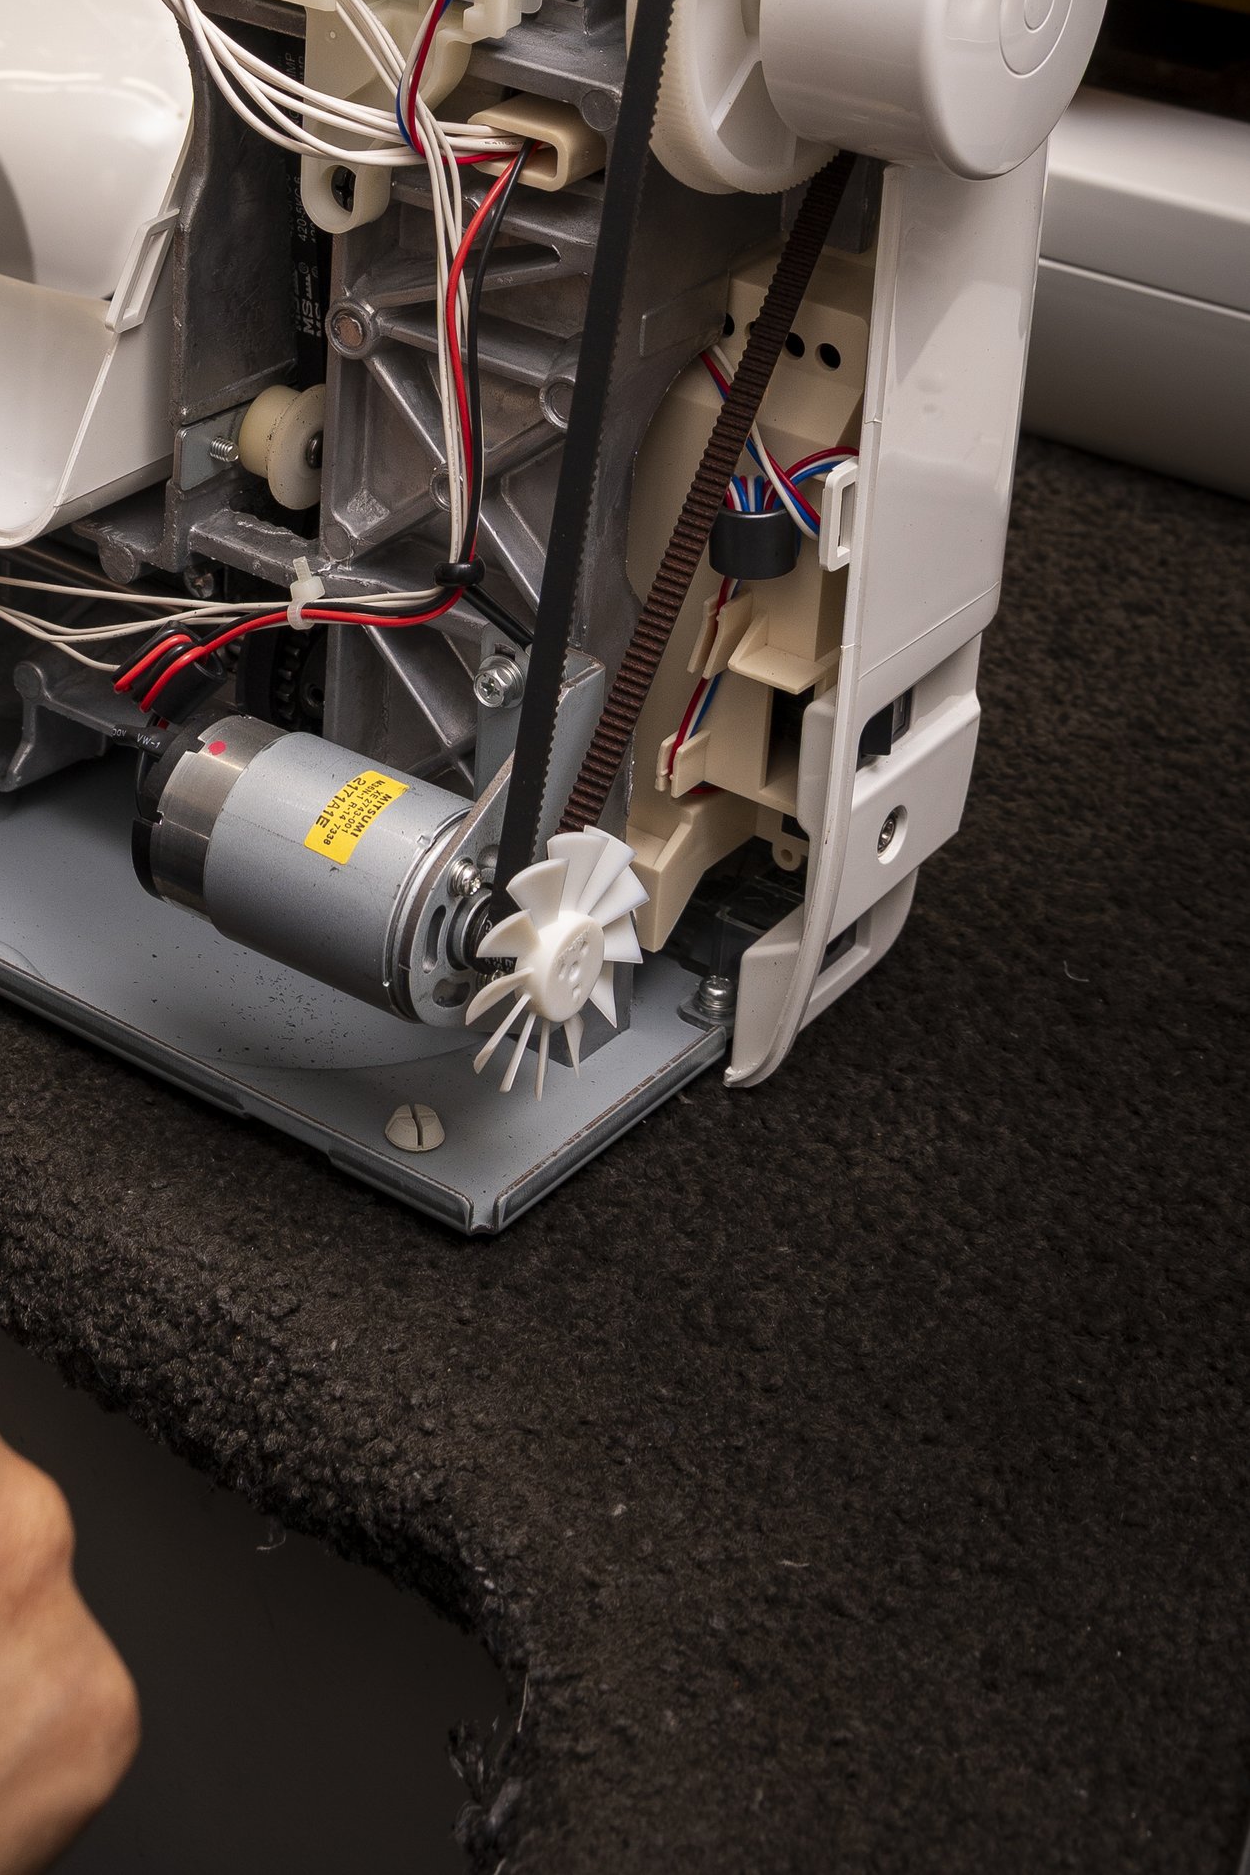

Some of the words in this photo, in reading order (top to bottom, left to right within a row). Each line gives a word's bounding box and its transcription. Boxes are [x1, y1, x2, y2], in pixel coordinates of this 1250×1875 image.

[137, 733, 161, 749] VW-1
[315, 777, 367, 829] 2171A1E
[370, 789, 382, 800] XE
[339, 801, 357, 820] R-14
[341, 798, 373, 834] 2743-001
[350, 793, 393, 838] MITSUMI
[323, 823, 341, 846] 7338
